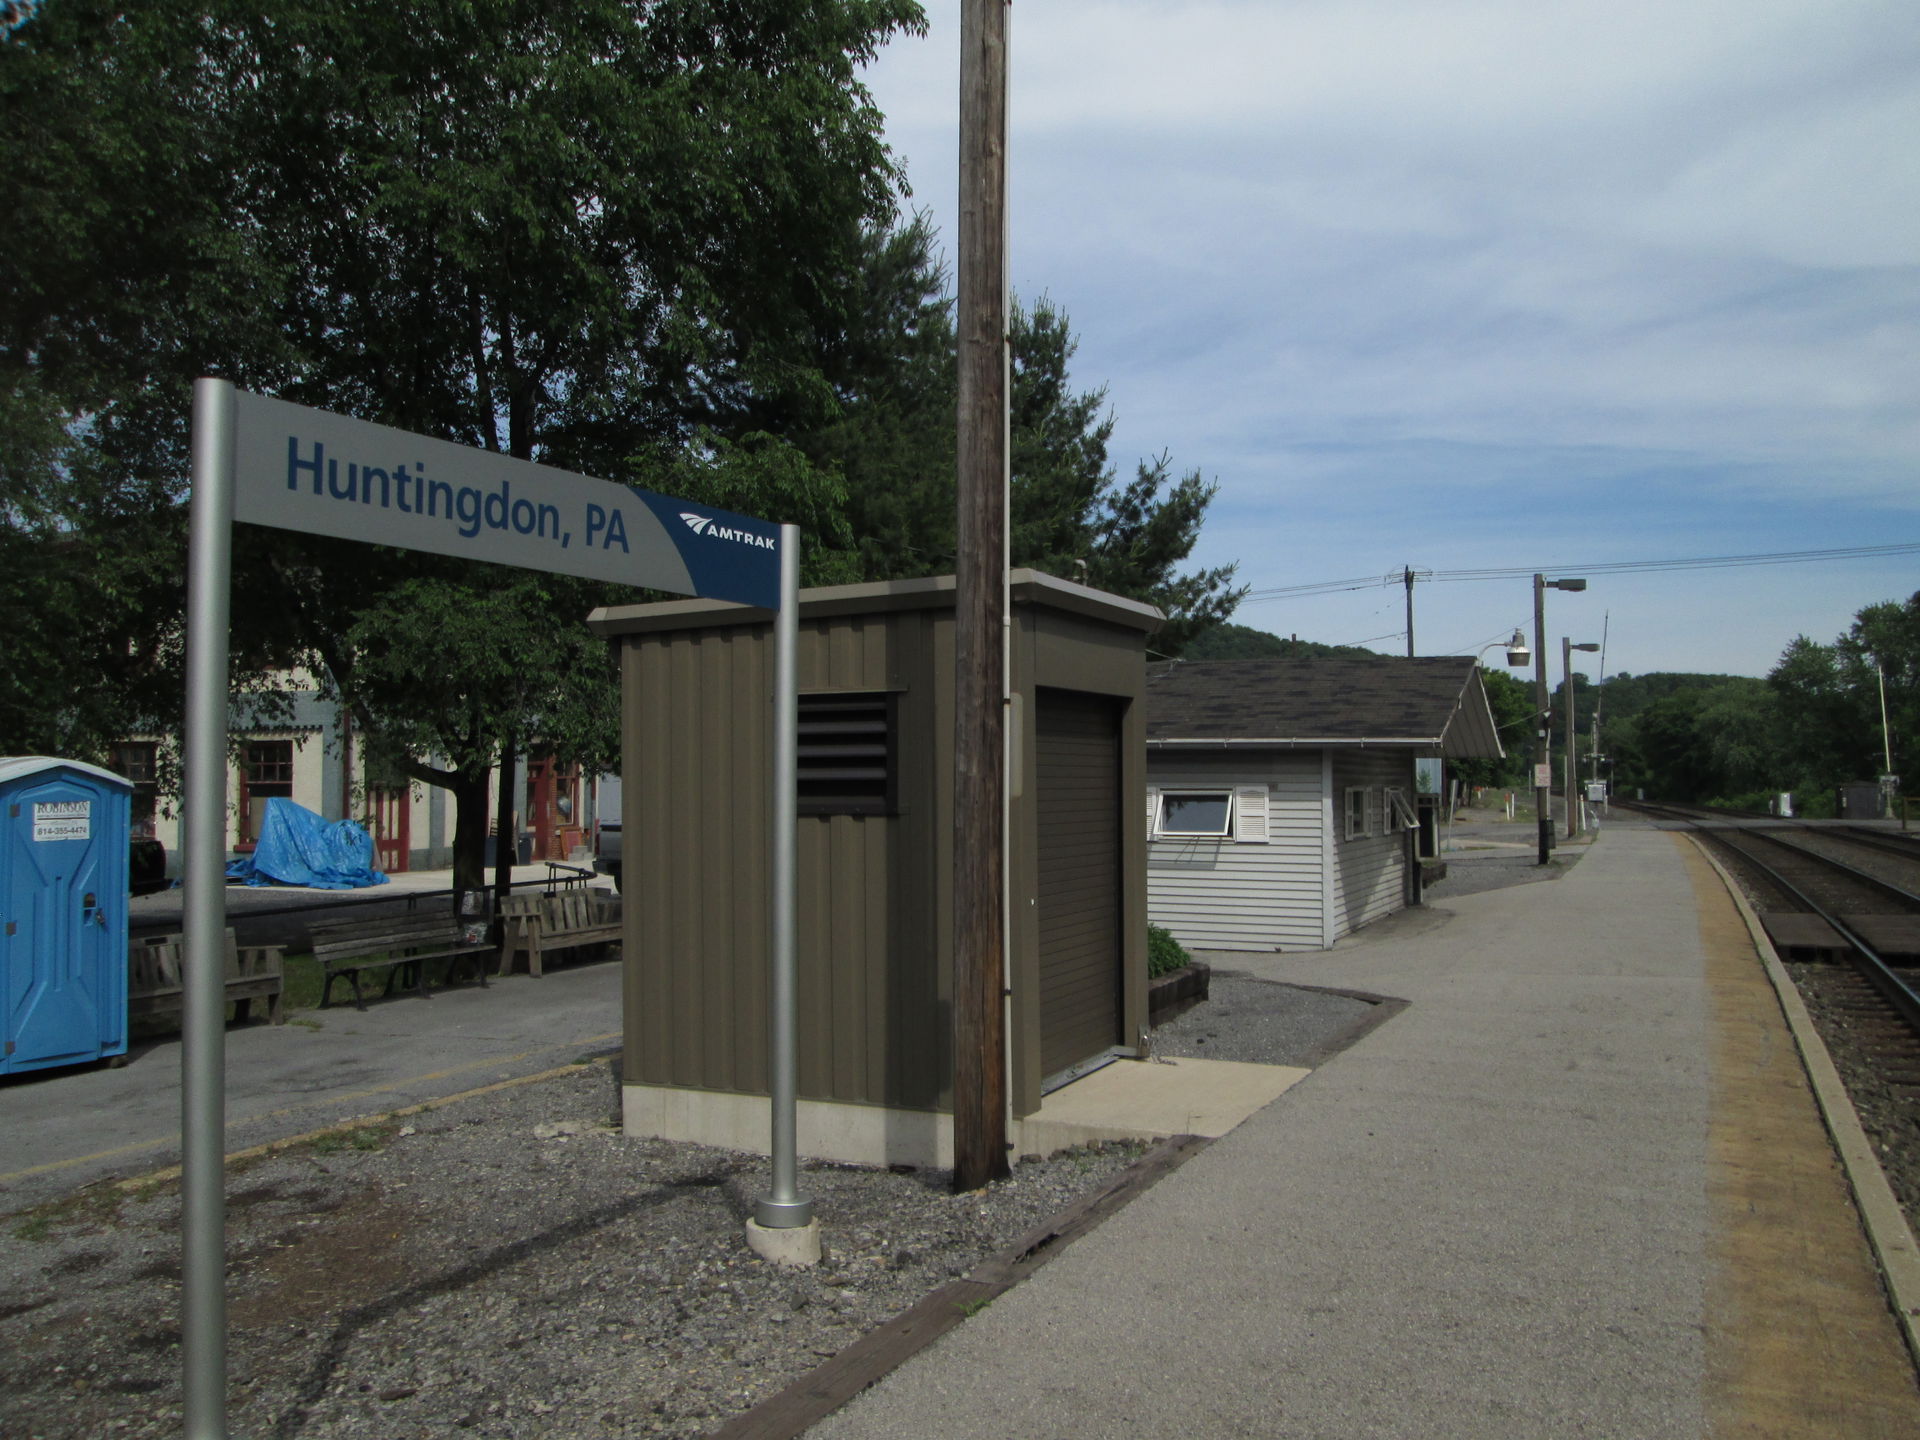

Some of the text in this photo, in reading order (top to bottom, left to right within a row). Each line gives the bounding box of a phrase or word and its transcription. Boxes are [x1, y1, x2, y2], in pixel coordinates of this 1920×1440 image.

[287, 435, 630, 554] Huntingdon, PA
[706, 524, 776, 551] AMTRAK
[37, 801, 89, 814] ROBINSON
